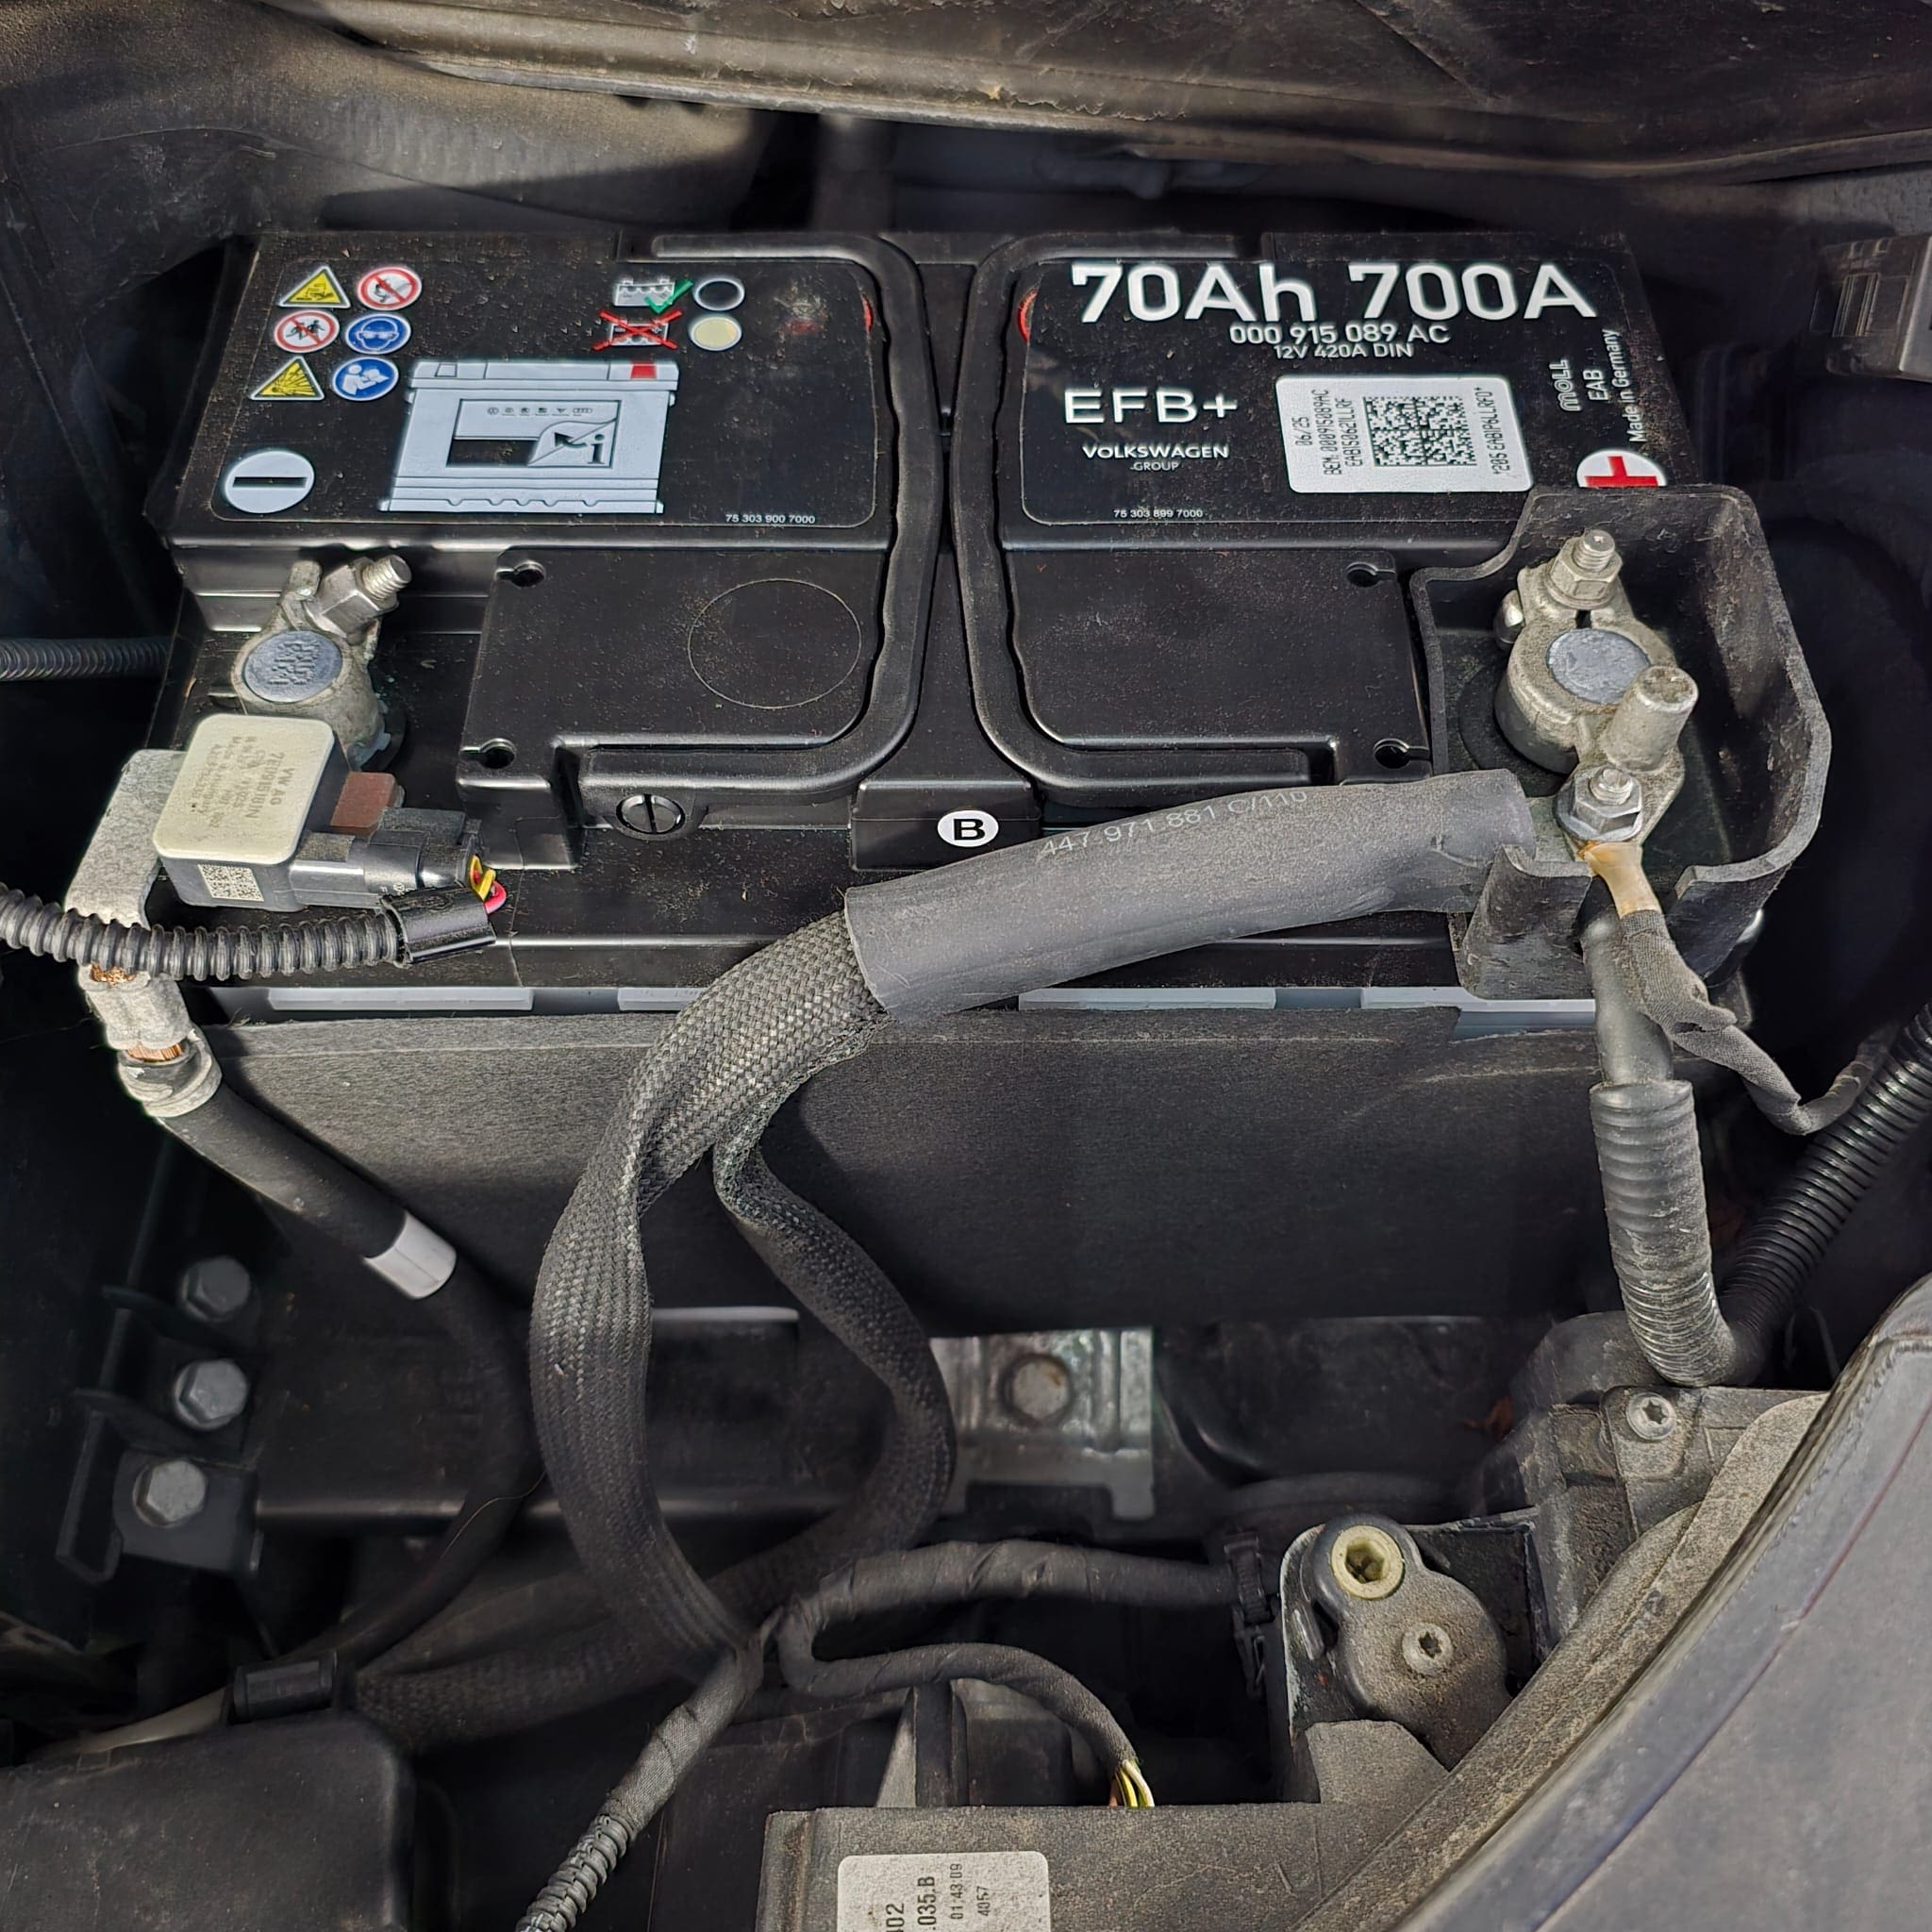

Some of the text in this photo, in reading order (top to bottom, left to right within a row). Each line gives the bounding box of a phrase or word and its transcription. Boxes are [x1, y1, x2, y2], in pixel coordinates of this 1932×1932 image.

[1071, 262, 1596, 322] 70Ah 700A
[1229, 324, 1451, 343] 000 915 089 AC
[1274, 342, 1414, 358] 12V 420A DIN
[1582, 369, 1608, 401] EAB
[1602, 328, 1648, 442] Made in Germany
[1064, 389, 1238, 423] EFB+
[1291, 416, 1312, 446] 06/25
[1311, 389, 1338, 452] 000915089AC
[1082, 443, 1229, 458] VOLKSWAGEN
[1132, 461, 1179, 471] GROUP
[725, 514, 815, 524] 75 303 900 7000
[1113, 508, 1204, 518] 75 303 899 7000
[953, 818, 987, 841] B
[885, 1902, 906, 1932] 02
